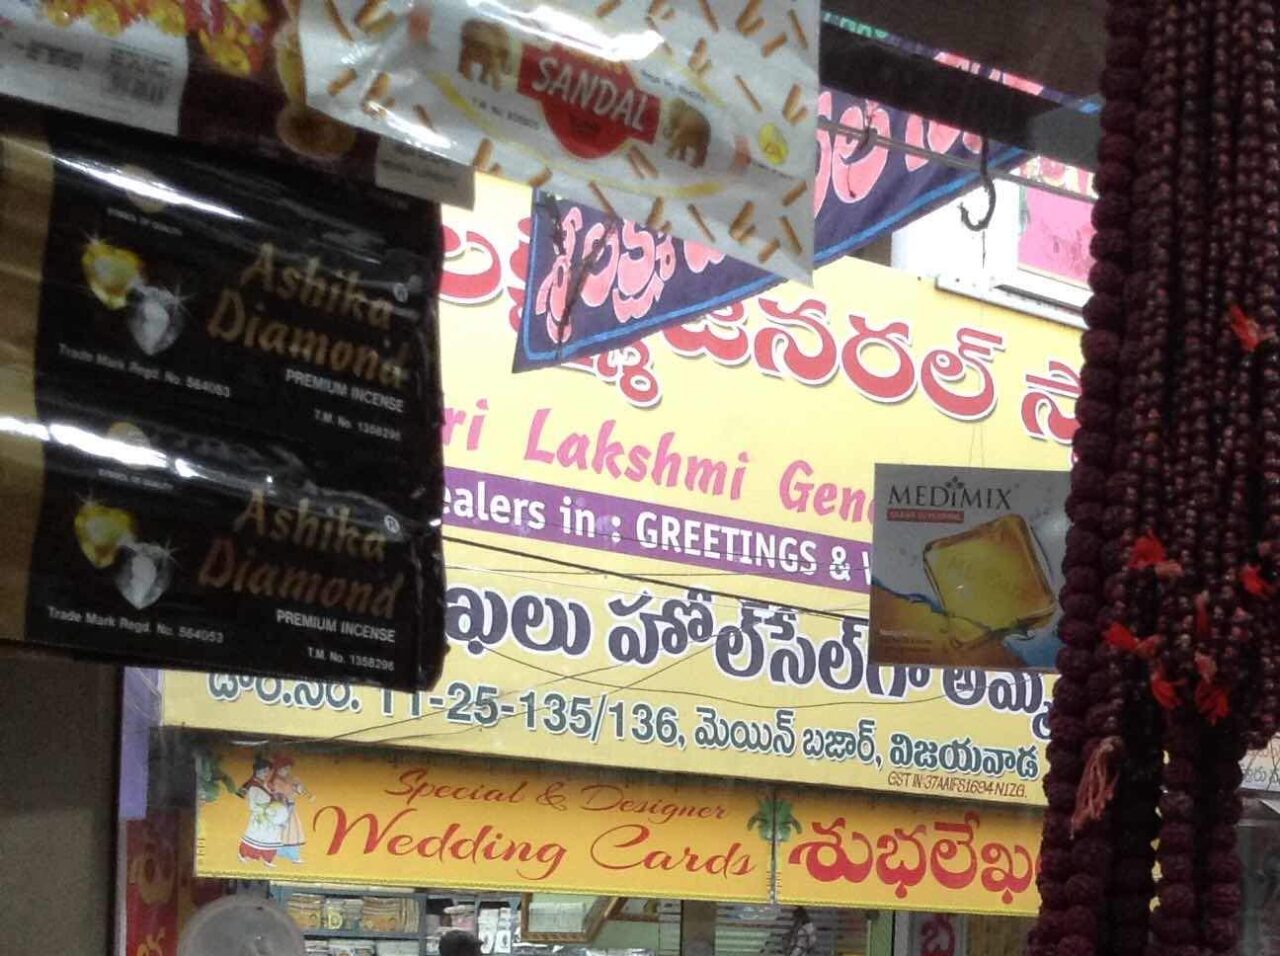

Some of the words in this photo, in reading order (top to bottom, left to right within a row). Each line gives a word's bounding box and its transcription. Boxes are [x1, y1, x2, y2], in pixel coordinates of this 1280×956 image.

[531, 55, 652, 132] SANDAL
[240, 242, 392, 331] Ashika
[58, 342, 93, 363] Trade
[96, 353, 125, 370] Mark
[206, 288, 409, 390] Diamond
[285, 368, 348, 397] PREMIUM
[351, 386, 403, 413] INCENSE
[443, 398, 489, 451] ri
[523, 408, 750, 500] Lakshmi
[778, 459, 873, 524] Gen
[232, 487, 388, 562] Ashika
[559, 494, 595, 539] in
[636, 510, 818, 575] GREETINGS
[828, 545, 851, 582] &
[47, 604, 82, 622] Trade
[85, 611, 116, 627] Mark
[197, 535, 405, 620] Diamond
[276, 608, 337, 633] PREMIUM
[340, 621, 396, 643] INCENSE
[308, 645, 326, 660] T.M.
[384, 767, 524, 805] Special
[535, 781, 568, 812] &
[579, 783, 730, 825] Designer
[312, 804, 568, 881] Wedding
[590, 822, 757, 880] Cards
